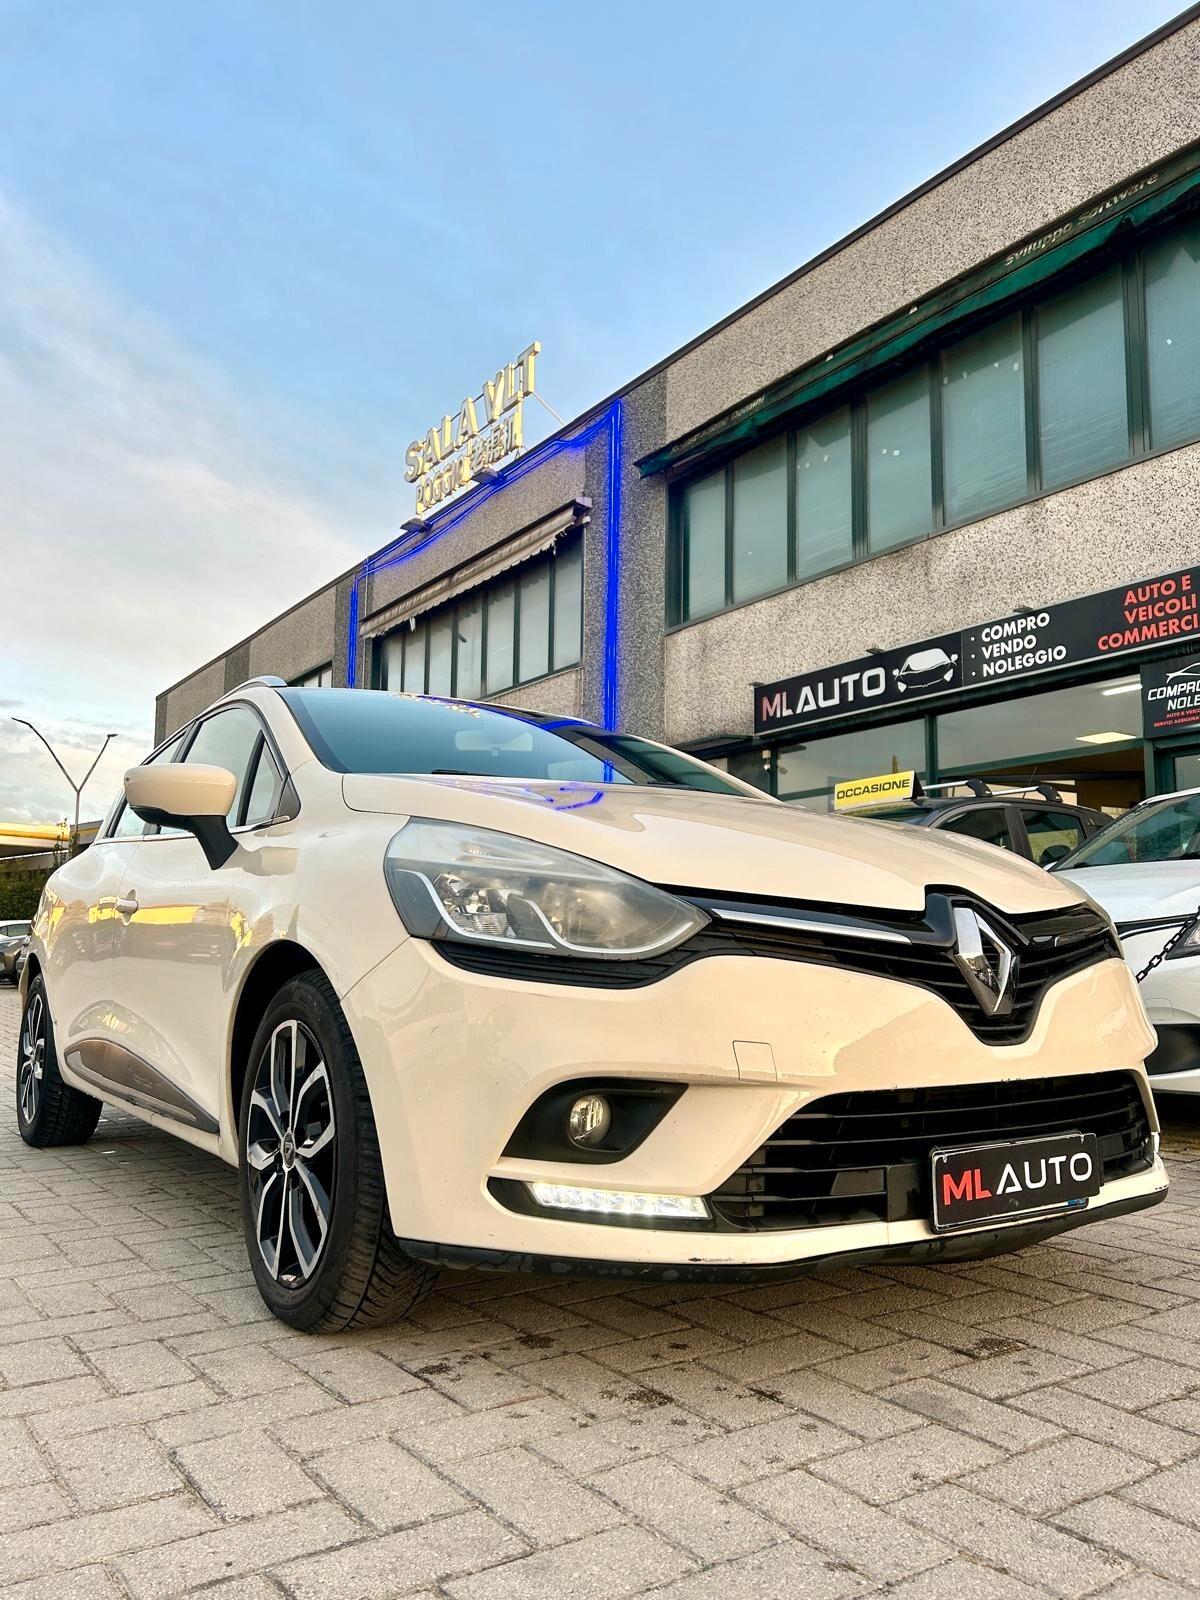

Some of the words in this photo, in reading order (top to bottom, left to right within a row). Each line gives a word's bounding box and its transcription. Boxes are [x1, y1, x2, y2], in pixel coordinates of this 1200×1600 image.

[404, 397, 479, 483] SALA
[482, 341, 542, 424] VLT
[1124, 579, 1177, 606] AUTO
[1181, 575, 1192, 591] E
[1124, 593, 1197, 624] VEICOLI
[981, 612, 1050, 642] COMPRO
[1097, 613, 1200, 651] COMMERCI
[981, 634, 1037, 659] VENDO
[982, 645, 1067, 677] NOLEGGIO
[762, 691, 794, 721] ML
[795, 667, 886, 714] AUTO
[836, 778, 911, 800] OCCASIONE
[942, 1168, 992, 1206] ML
[996, 1152, 1093, 1195] AUTO
